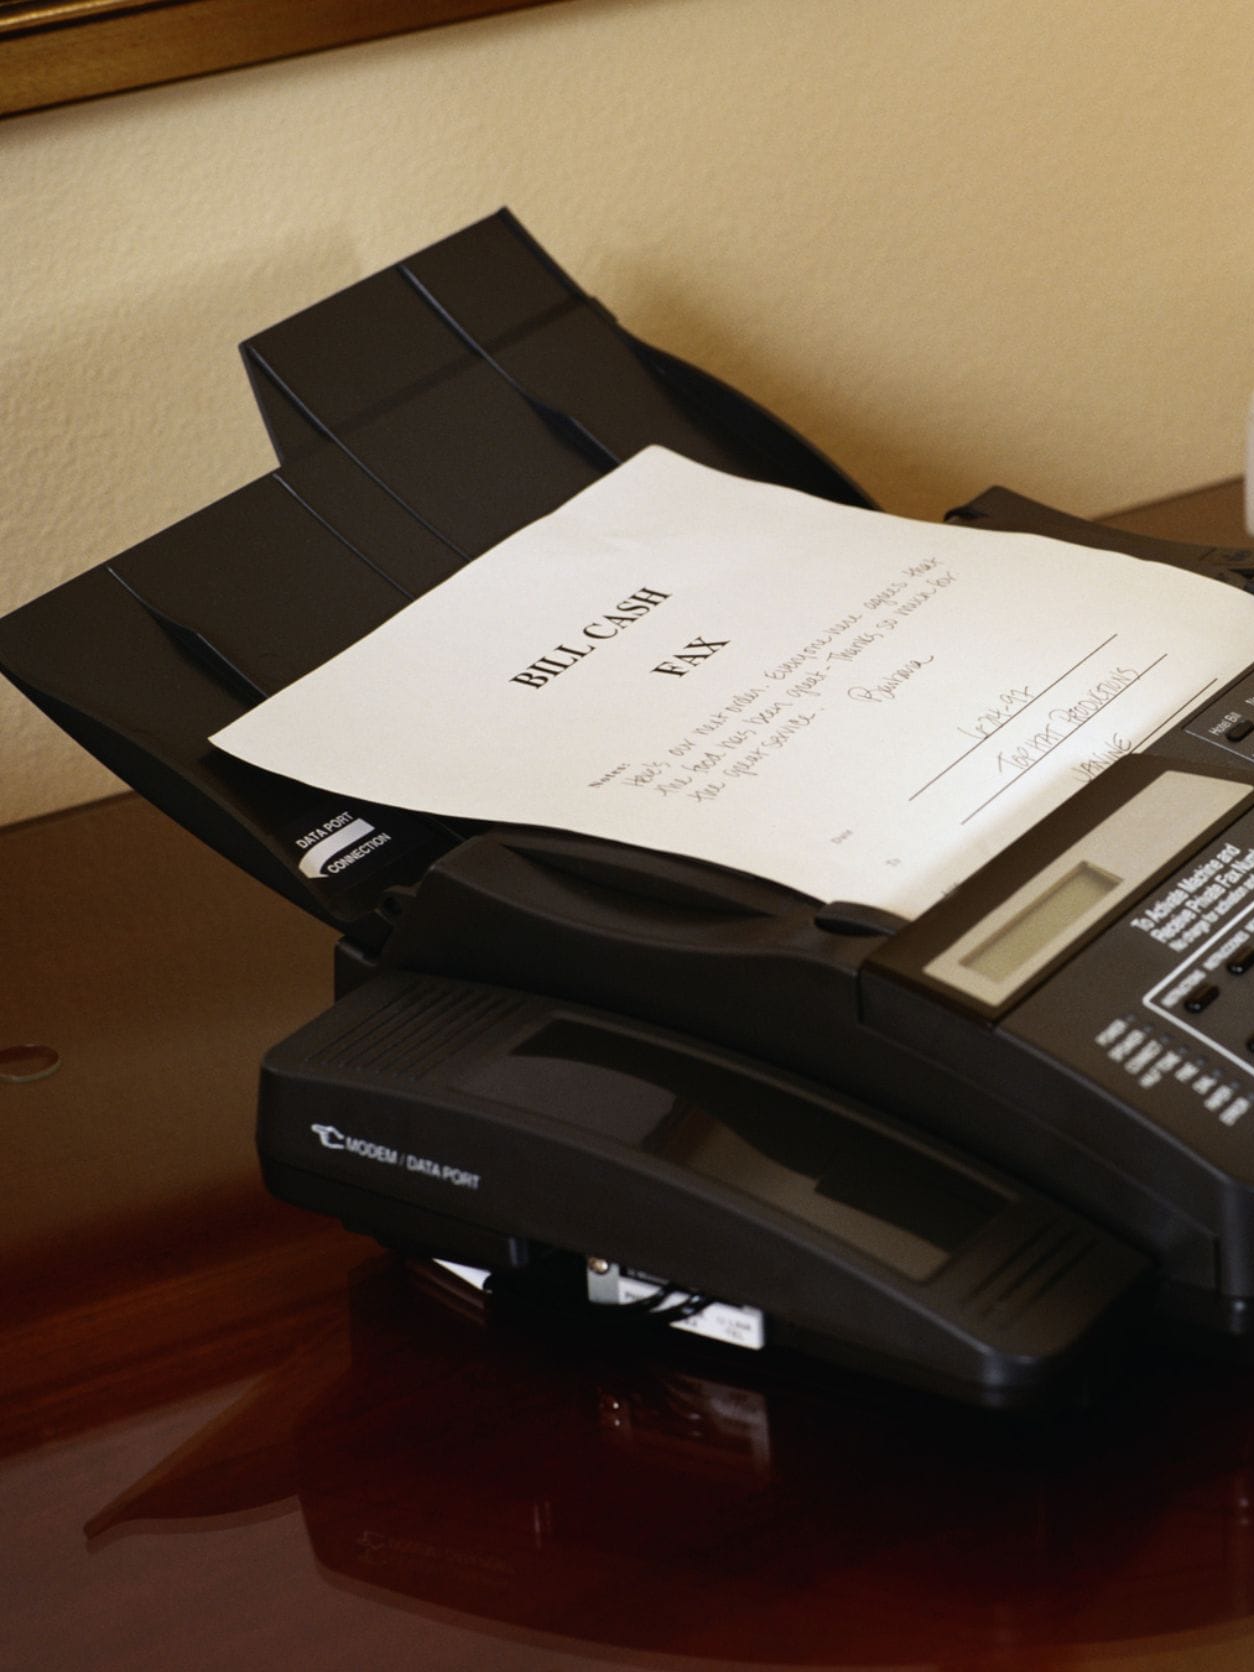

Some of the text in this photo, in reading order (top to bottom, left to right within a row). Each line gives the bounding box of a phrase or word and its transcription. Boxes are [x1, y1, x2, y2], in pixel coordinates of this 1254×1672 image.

[508, 586, 673, 689] BILL CASH
[649, 636, 731, 677] FAX
[669, 739, 696, 757] our
[693, 713, 729, 735] next
[765, 636, 832, 680] Everyone
[824, 614, 863, 635] here
[864, 582, 907, 610] agrees
[903, 557, 944, 577] that
[681, 752, 726, 774] food
[718, 727, 756, 750] has
[743, 701, 793, 726] been
[876, 618, 899, 631] so
[895, 587, 937, 616] much
[926, 570, 958, 588] for
[1048, 666, 1142, 725] PRODUCTIONS
[1209, 709, 1242, 737] Hotel Bill
[295, 811, 354, 849] DATA PORT
[326, 832, 392, 874] CONNECTION
[1130, 842, 1241, 933] To Activate Machine and
[1149, 905, 1196, 943] Receive
[1185, 881, 1226, 914] Private
[1214, 866, 1243, 888] Fax
[345, 1136, 398, 1164] MODEM
[406, 1154, 441, 1179] DATA
[441, 1165, 481, 1190] PORT
